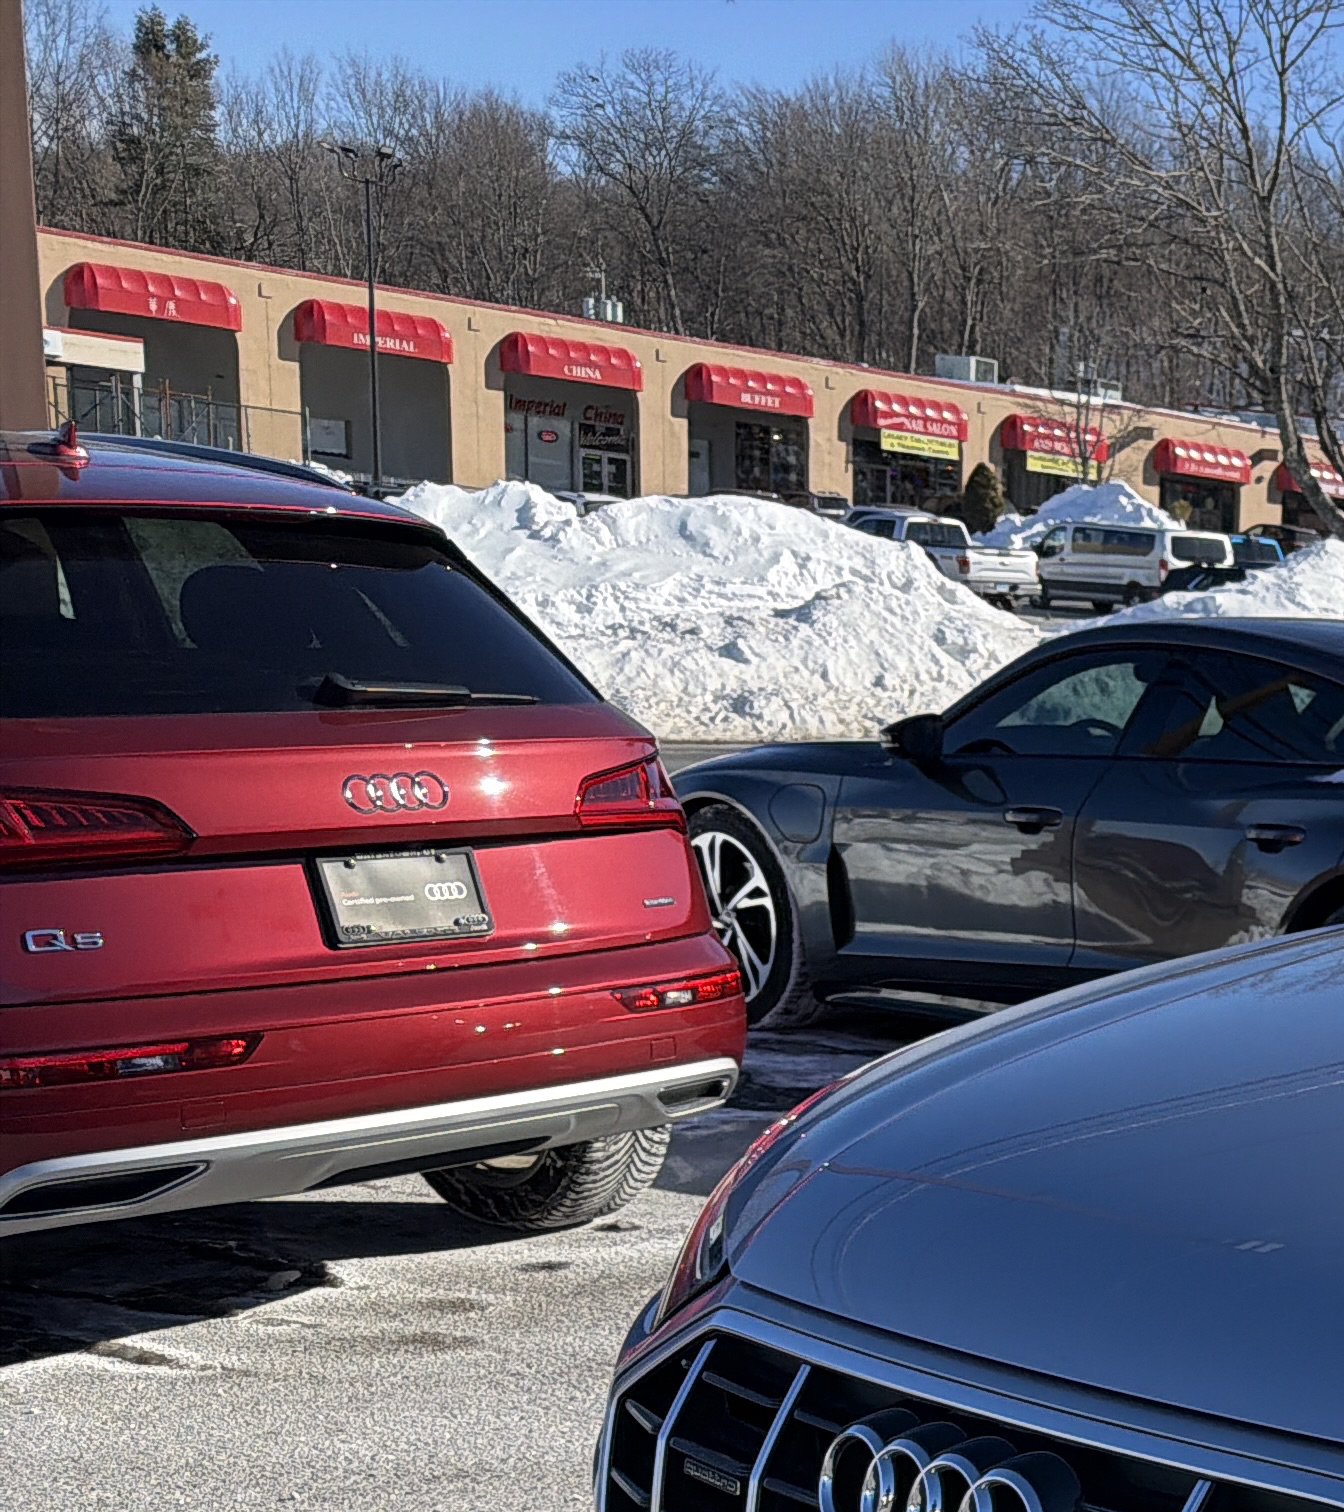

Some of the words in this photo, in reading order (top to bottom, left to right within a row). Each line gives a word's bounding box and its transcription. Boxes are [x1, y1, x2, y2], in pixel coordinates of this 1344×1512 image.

[563, 364, 602, 380] CHINA
[509, 394, 567, 418] Imperial
[583, 405, 625, 425] China
[25, 928, 104, 952] Q5
